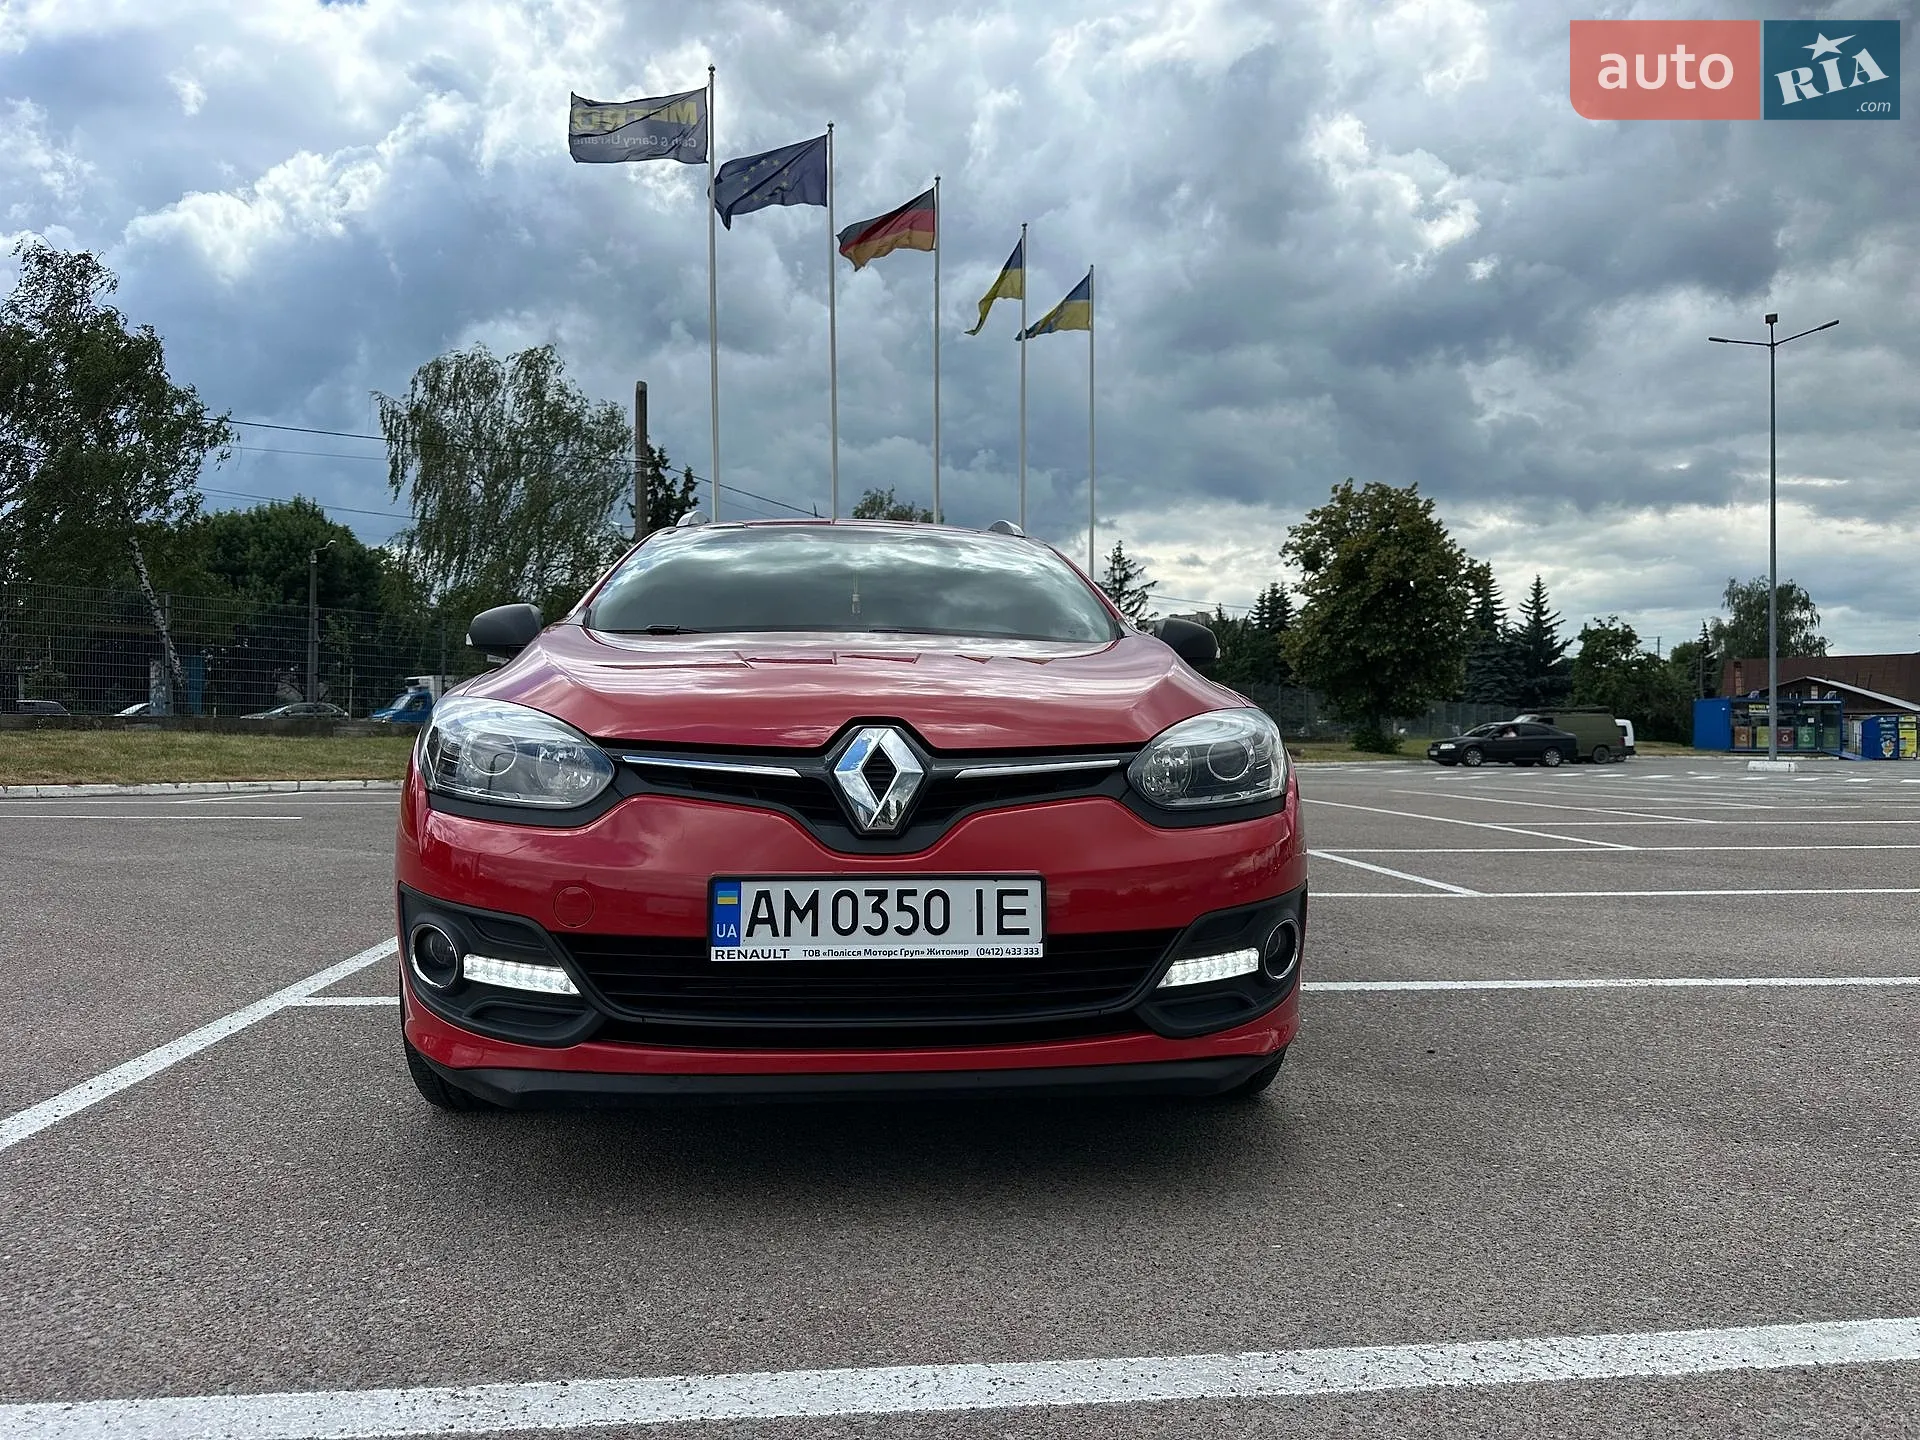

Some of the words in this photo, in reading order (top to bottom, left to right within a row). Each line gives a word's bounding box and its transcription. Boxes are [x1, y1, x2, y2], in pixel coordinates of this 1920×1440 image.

[716, 923, 738, 939] UA
[715, 948, 790, 960] RENAULT
[802, 949, 820, 957] ТОВ
[822, 948, 862, 957] «Полісся
[863, 948, 898, 957] Моторс
[899, 948, 925, 958] Груп»
[926, 948, 969, 957] Житомир
[976, 947, 1004, 957] (0412)
[1005, 947, 1022, 956] 433
[1023, 947, 1040, 956] 333
